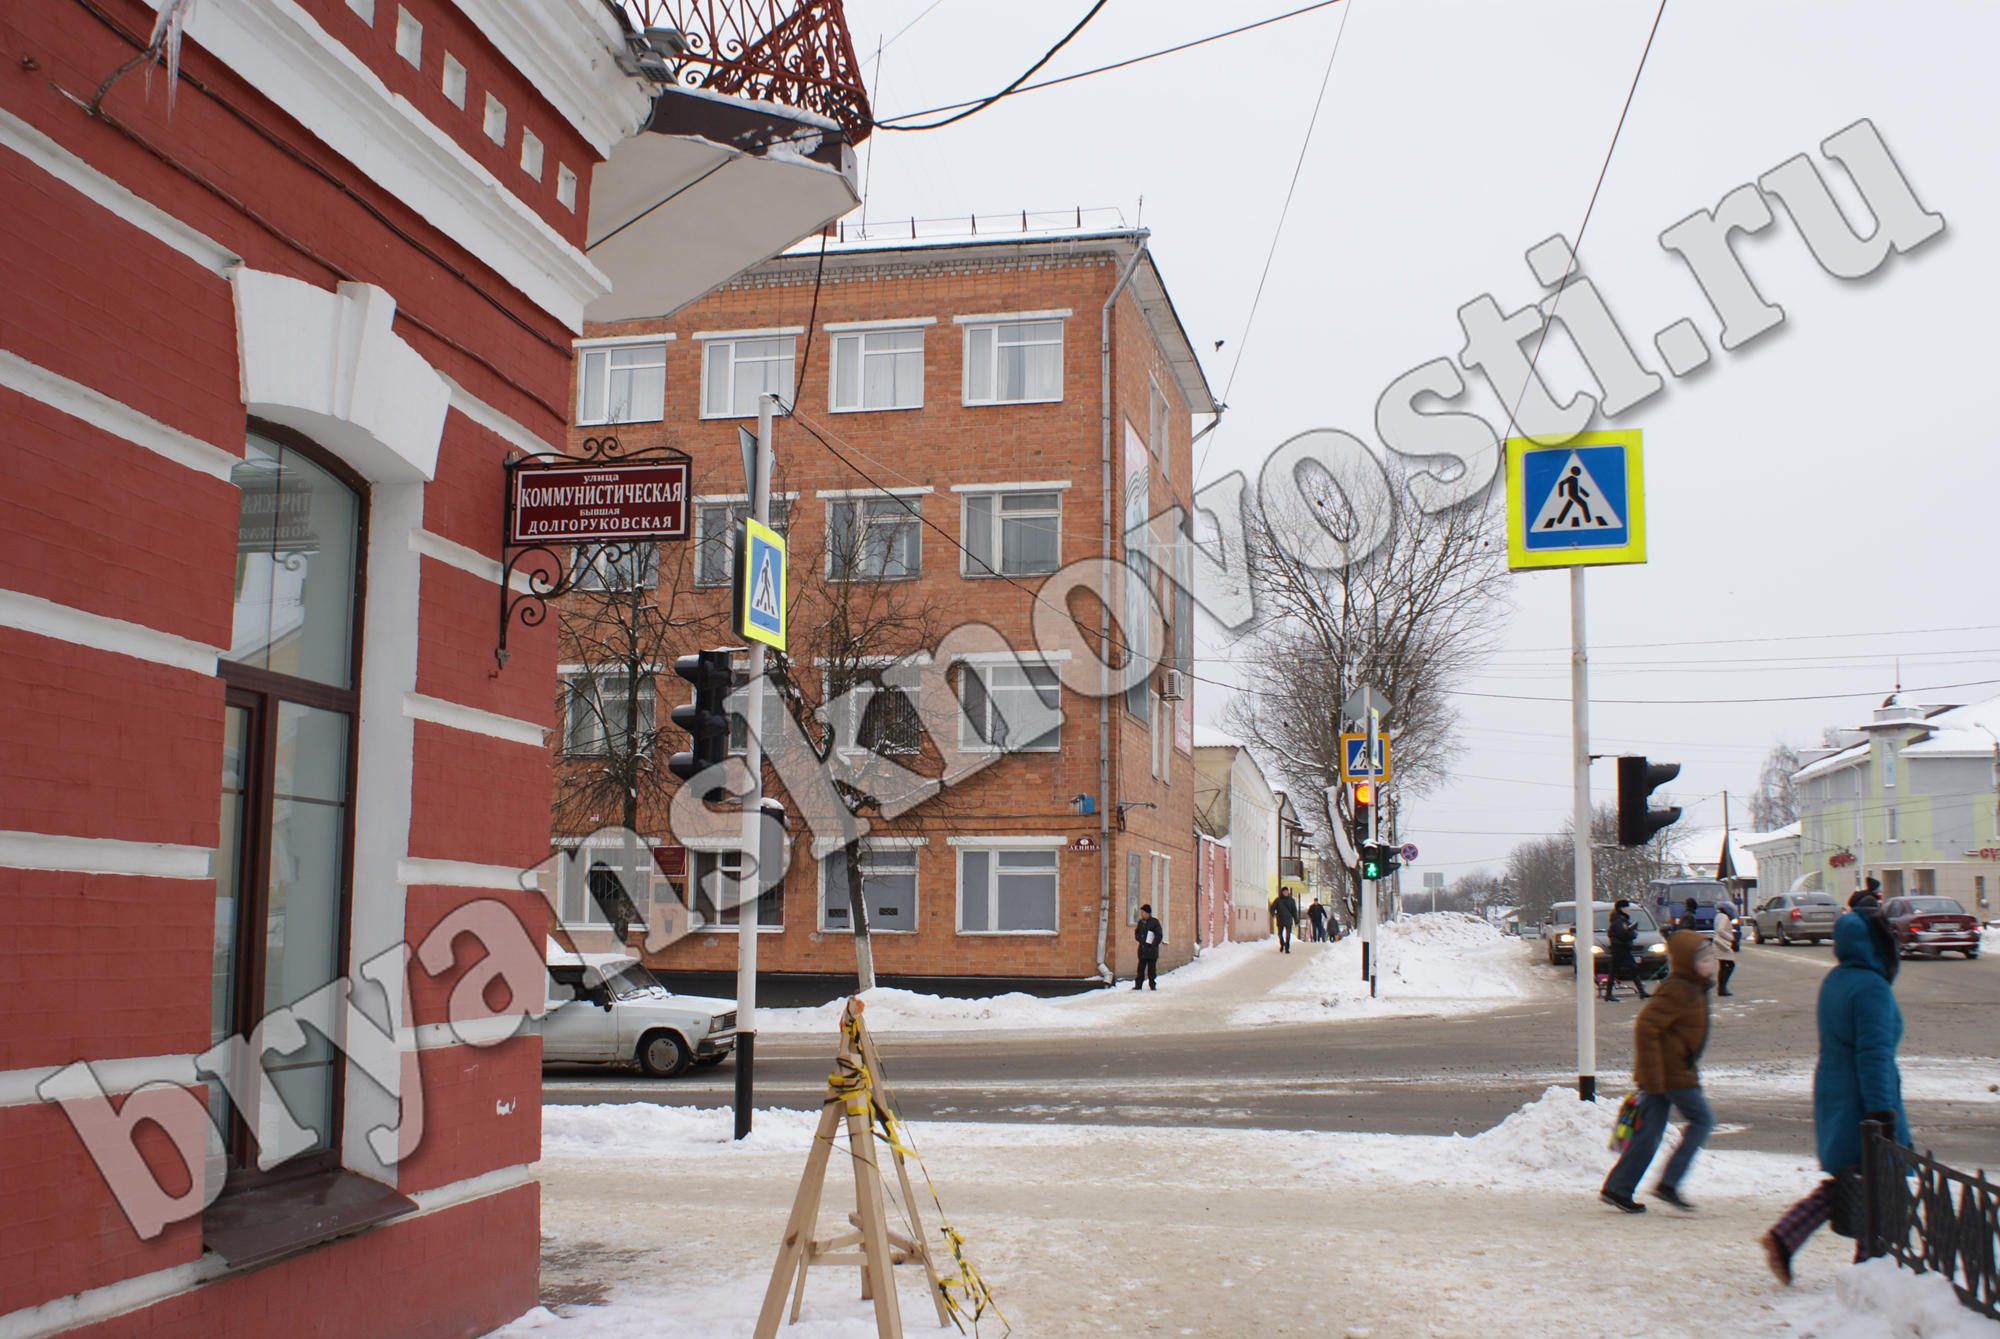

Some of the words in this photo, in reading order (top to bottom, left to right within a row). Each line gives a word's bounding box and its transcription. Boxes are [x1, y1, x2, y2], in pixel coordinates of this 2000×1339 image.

[583, 474, 620, 484] улица
[521, 482, 682, 508] КОММУНИСТИЧЕСКАЯ
[579, 509, 620, 517] БЫВШАЯ
[527, 516, 672, 534] ДОЛГОРУКОВСКАЯ
